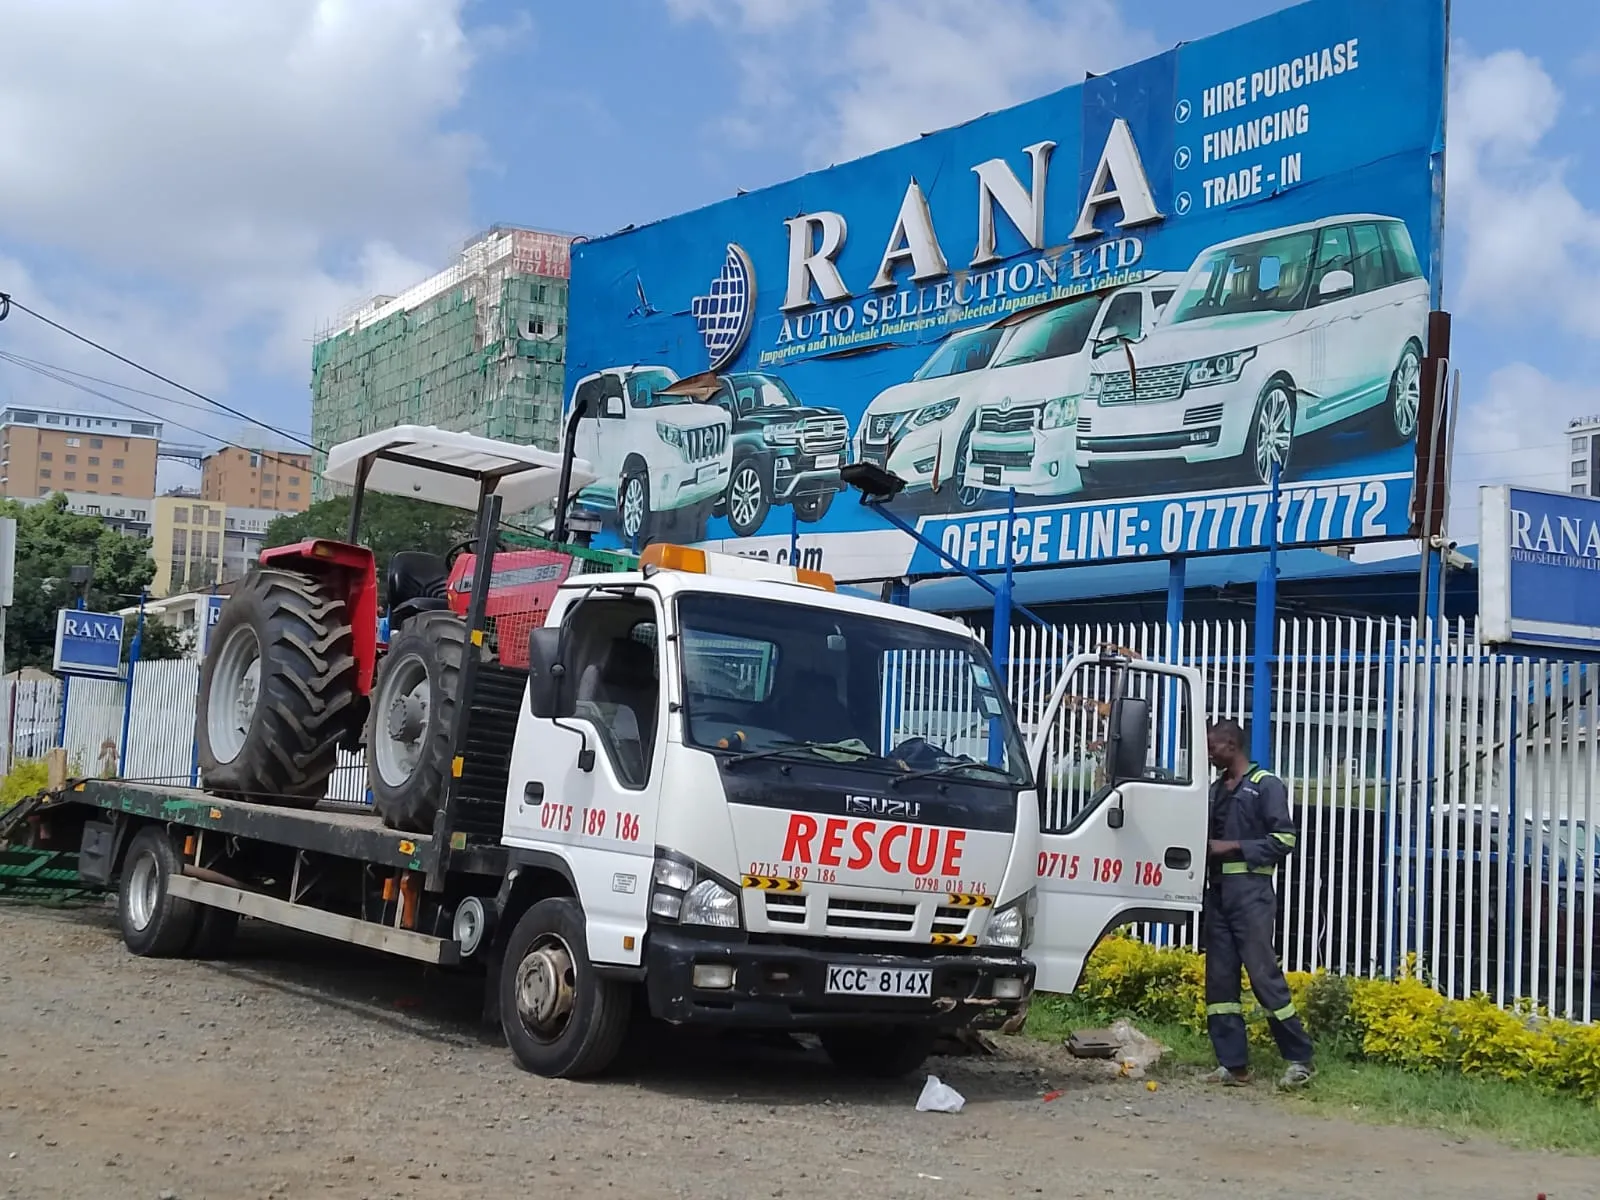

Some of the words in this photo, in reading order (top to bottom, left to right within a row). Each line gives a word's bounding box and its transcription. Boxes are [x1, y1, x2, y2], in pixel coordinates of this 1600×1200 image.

[1203, 77, 1246, 118] HIRE
[1251, 38, 1359, 102] PURCHASE
[1203, 104, 1309, 163] FINANCING
[1203, 164, 1262, 208] TRADE
[1281, 152, 1301, 186] IN
[779, 118, 1167, 311] RANA
[760, 343, 806, 363] Importers
[808, 335, 828, 350] and
[829, 325, 879, 347] Wholesale
[949, 301, 996, 322] Selected
[998, 291, 1048, 313] Japanes
[1051, 282, 1087, 299] Motor
[1091, 269, 1142, 290] Vehicles
[775, 305, 855, 344] AUTO
[862, 257, 1058, 327] SELLECTION
[1071, 236, 1144, 280] LTD
[940, 516, 1053, 570] OFFICE
[1058, 507, 1150, 561] LINE:
[1509, 509, 1600, 559] RANA
[65, 618, 120, 640] RANA
[541, 802, 573, 832] 0715
[581, 808, 606, 836] 189
[615, 812, 640, 841] 186
[845, 795, 921, 819] ISUZU
[781, 813, 967, 877] RESCUE
[1036, 851, 1080, 880] 0715
[1092, 858, 1123, 884] 189
[1134, 861, 1163, 887] 186
[750, 862, 779, 878] 0715
[788, 865, 808, 880] 189
[816, 868, 836, 882] 186
[914, 877, 939, 891] 0798
[945, 879, 963, 893] 018
[970, 881, 987, 895] 745
[829, 968, 868, 991] KCC
[879, 971, 930, 995] 814X
